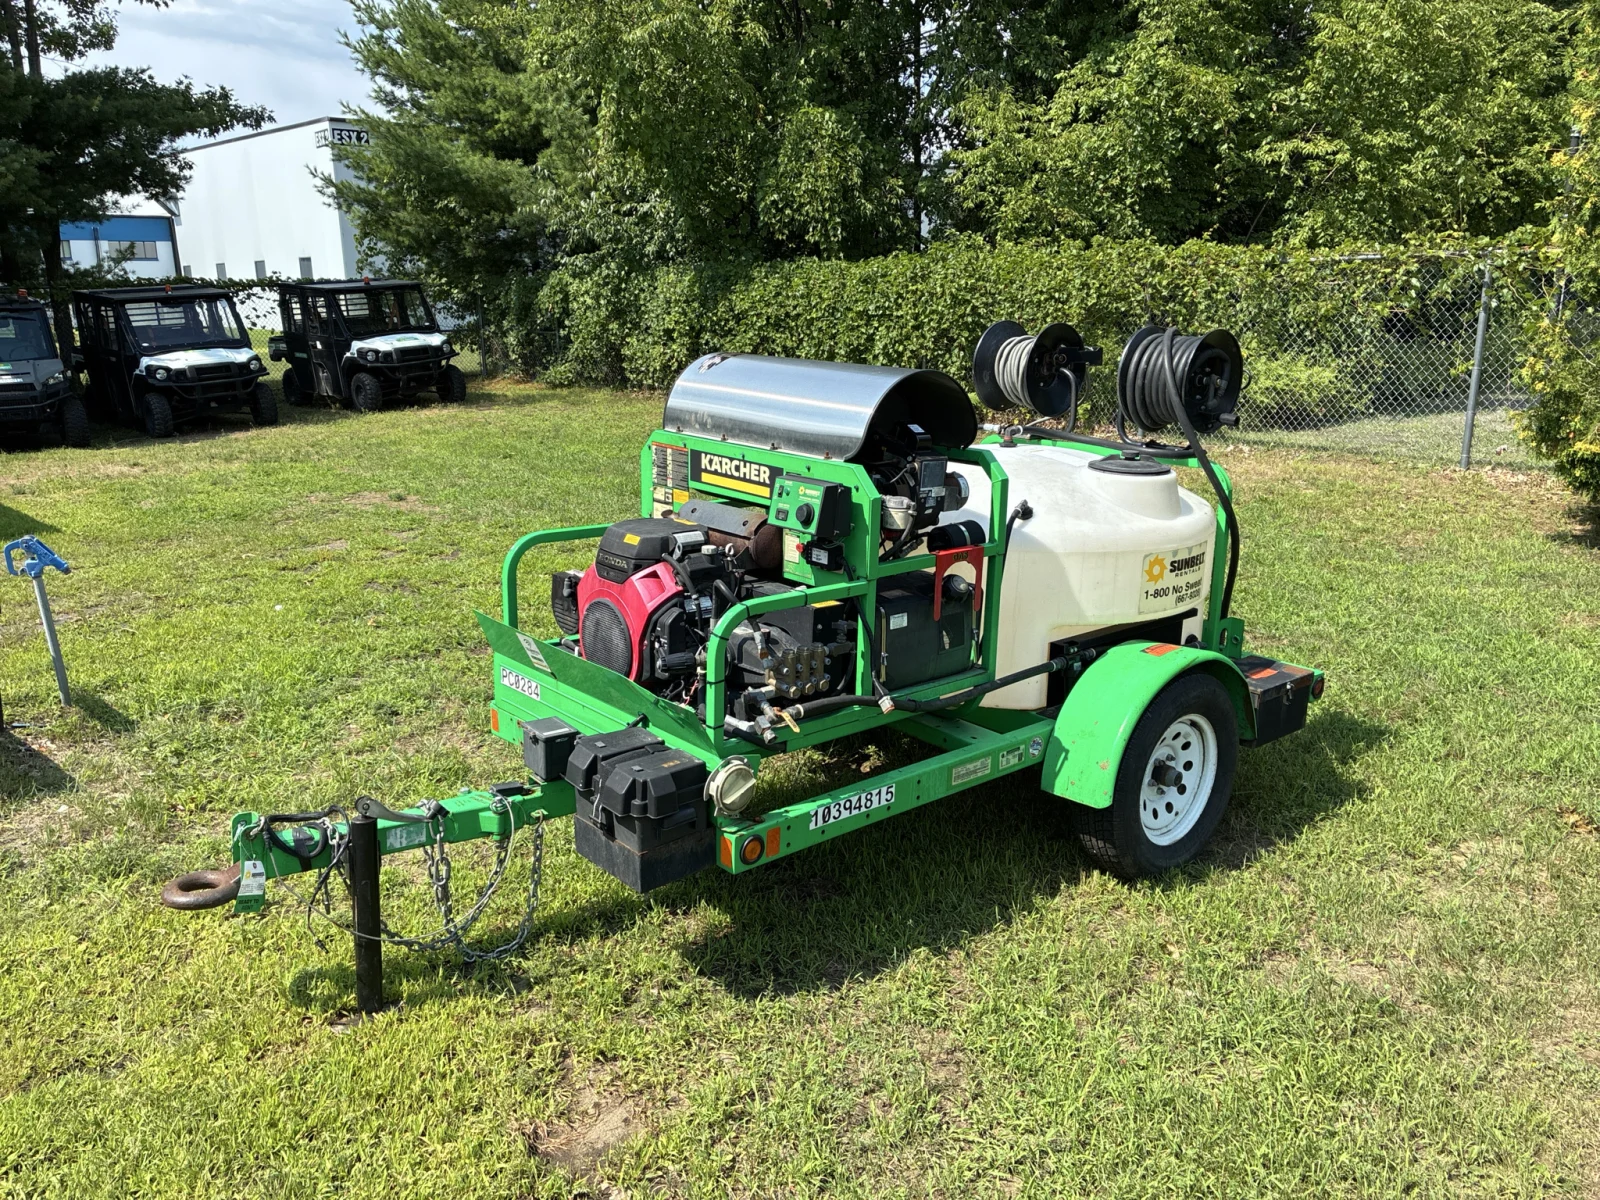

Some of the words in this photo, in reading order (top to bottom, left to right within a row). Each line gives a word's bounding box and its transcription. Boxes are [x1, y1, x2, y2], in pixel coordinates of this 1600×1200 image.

[333, 130, 357, 145] ESX
[360, 132, 368, 145] 2
[701, 453, 771, 484] KÄRCHER
[1169, 552, 1205, 573] SUNBELT
[1144, 586, 1170, 600] 1-800
[1171, 584, 1184, 595] No
[502, 668, 539, 698] PC0284
[811, 784, 895, 828] 10394815
